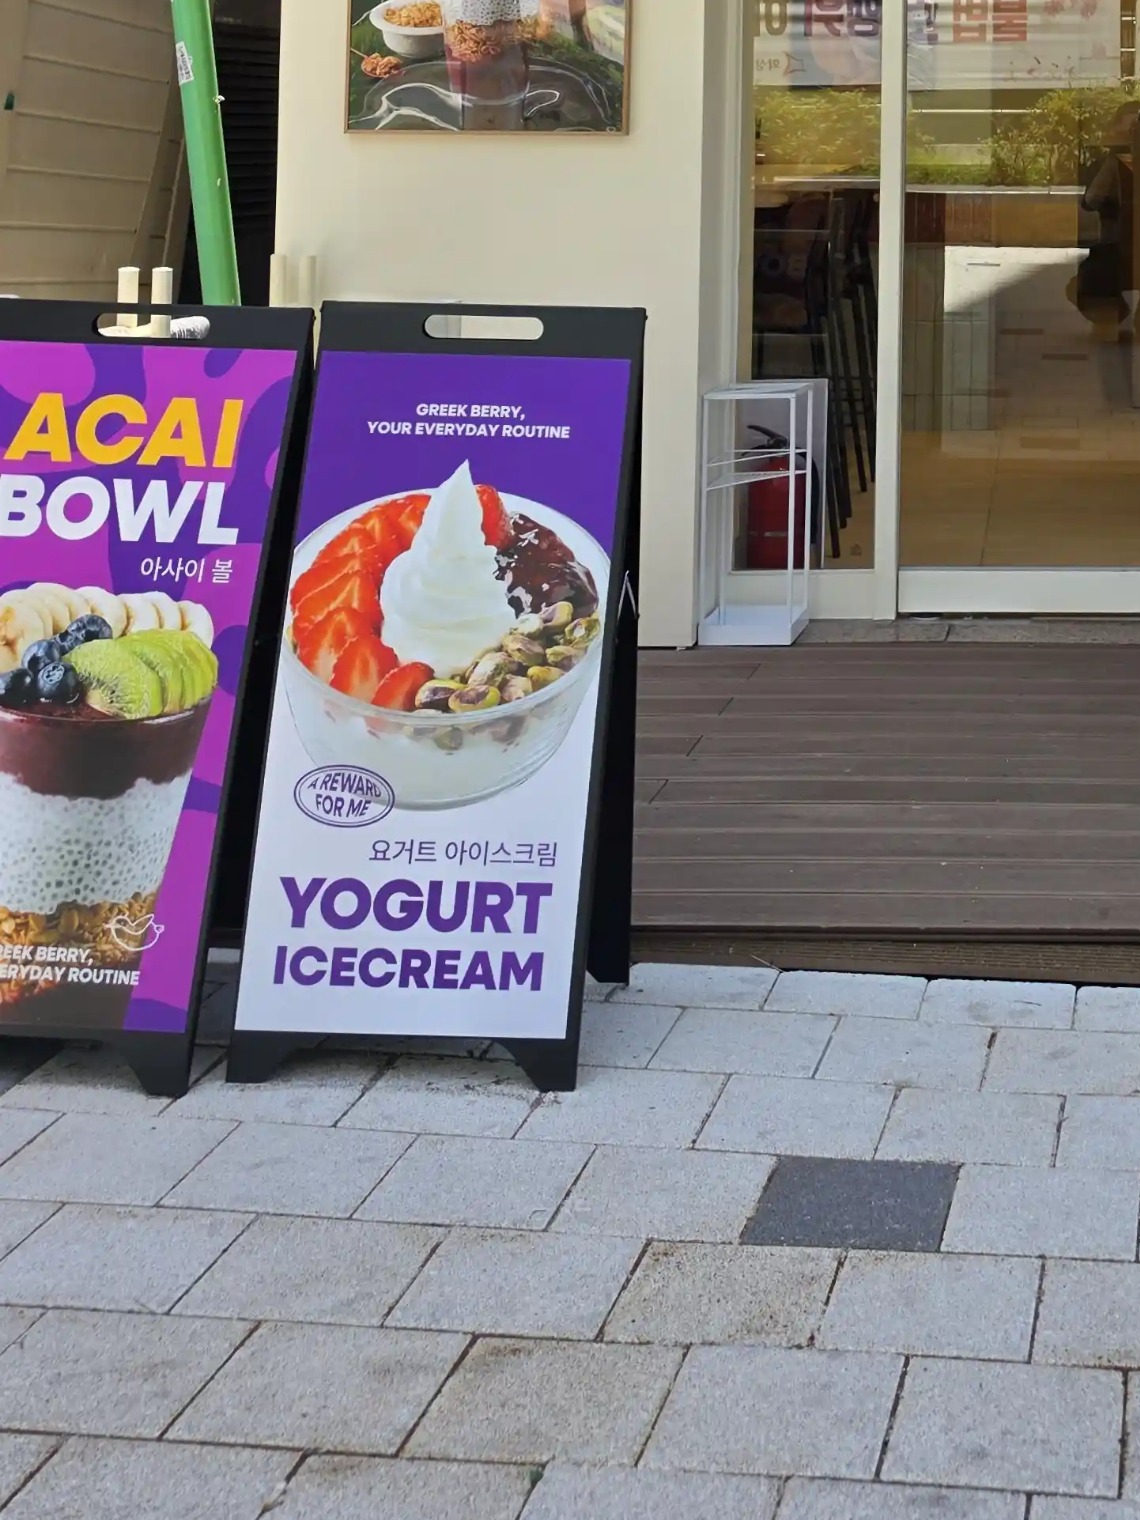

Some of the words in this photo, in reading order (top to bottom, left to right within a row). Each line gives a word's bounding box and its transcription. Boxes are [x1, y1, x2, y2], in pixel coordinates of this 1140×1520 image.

[416, 403, 468, 417] GREEK
[470, 405, 526, 421] BERRY,
[4, 392, 243, 468] ACAI
[367, 421, 412, 435] YOUR
[414, 422, 500, 437] EVERYDAY
[501, 425, 571, 439] ROUTINE
[0, 473, 239, 545] BOWL
[140, 556, 205, 583] 아사이
[211, 558, 233, 584] 볼
[308, 776, 320, 790] A
[319, 772, 382, 798] REWARD
[315, 793, 345, 818] FOR
[346, 798, 372, 818] ME
[369, 839, 437, 865] 요거트
[445, 840, 558, 867] 아이스크림
[279, 876, 553, 934] YOGURT
[0, 944, 34, 960] EEK
[35, 946, 94, 967] BERRY,
[273, 945, 545, 991] ICECREAM
[0, 963, 66, 982] ERYDAY
[67, 967, 141, 986] ROUTINE
